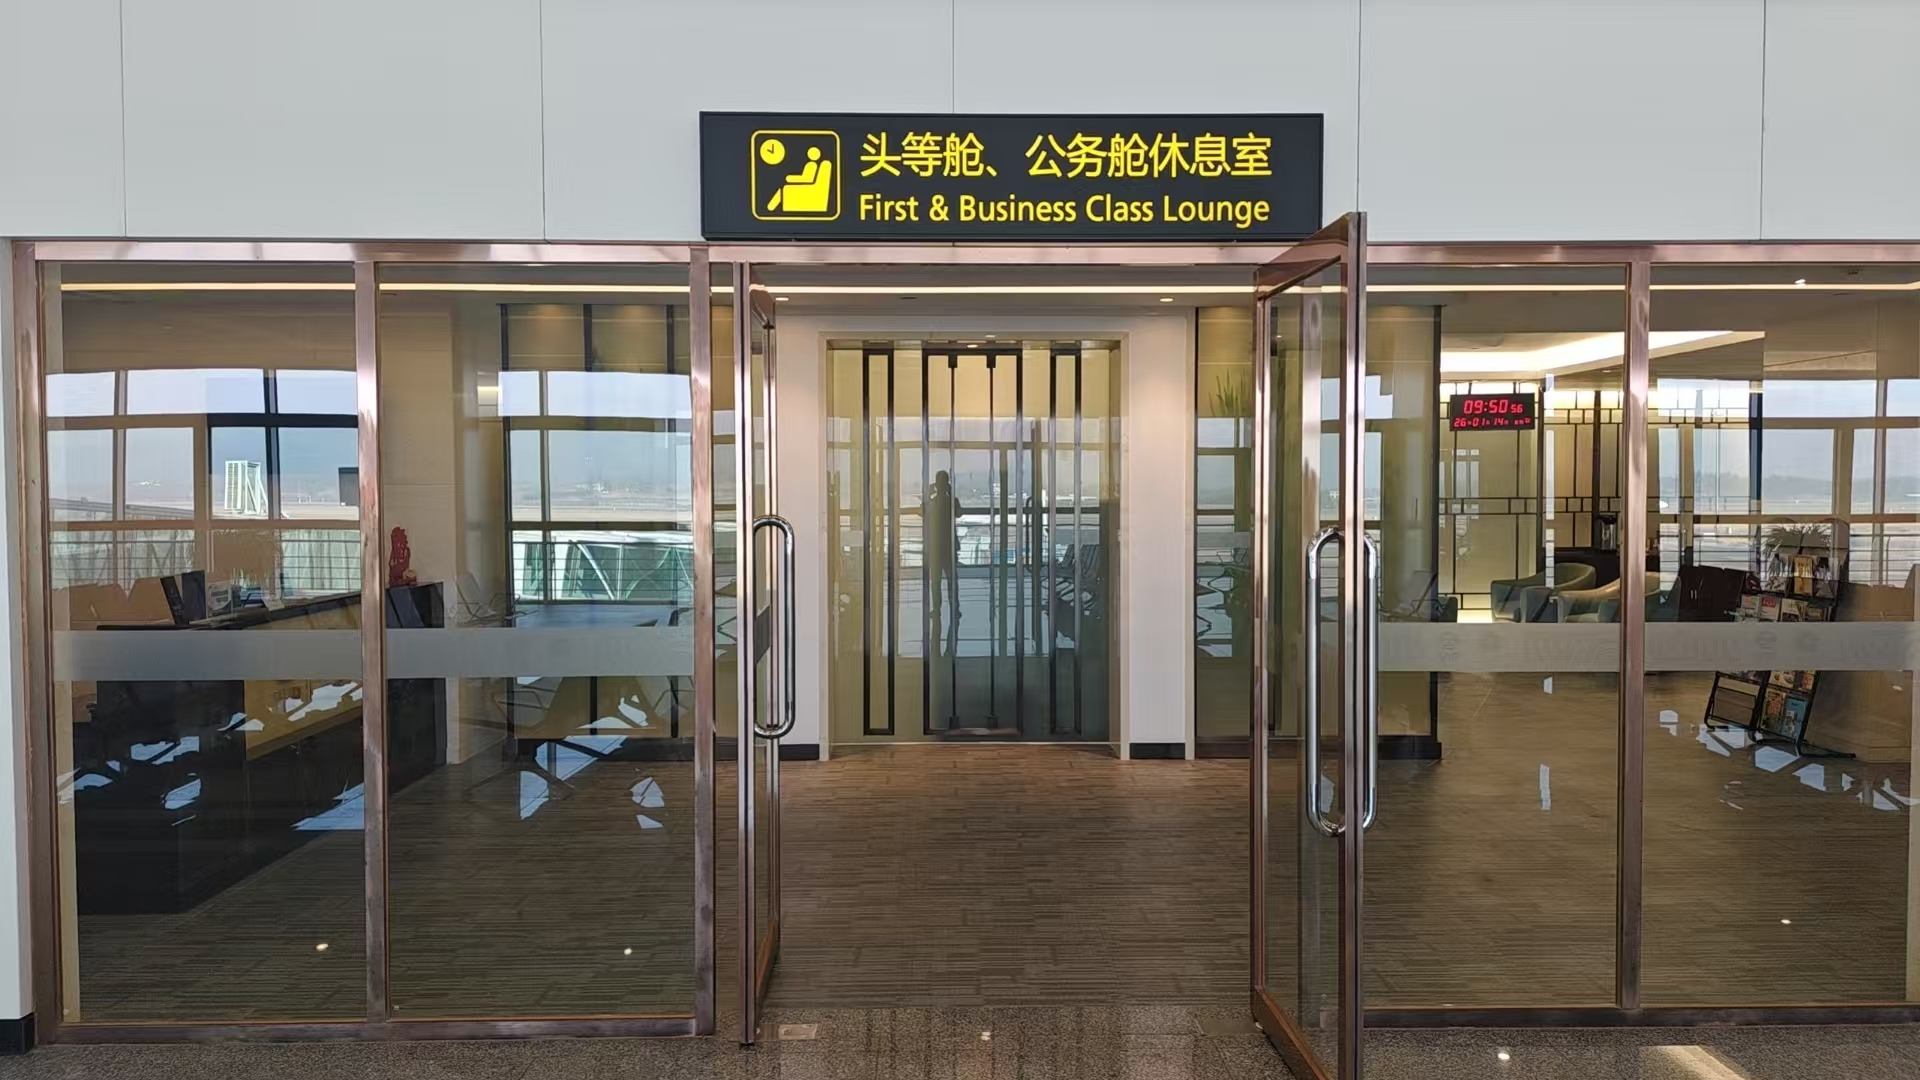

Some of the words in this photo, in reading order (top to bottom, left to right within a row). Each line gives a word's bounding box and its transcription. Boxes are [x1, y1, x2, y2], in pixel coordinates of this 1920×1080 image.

[860, 130, 1273, 179] 头等舱、公务舱休息室
[859, 193, 919, 223] First
[928, 194, 949, 223] &
[959, 193, 1077, 223] Business
[1085, 194, 1154, 223] Class
[1163, 195, 1270, 229] Lounge
[1463, 399, 1509, 414] 09:50
[1510, 404, 1523, 414] 56
